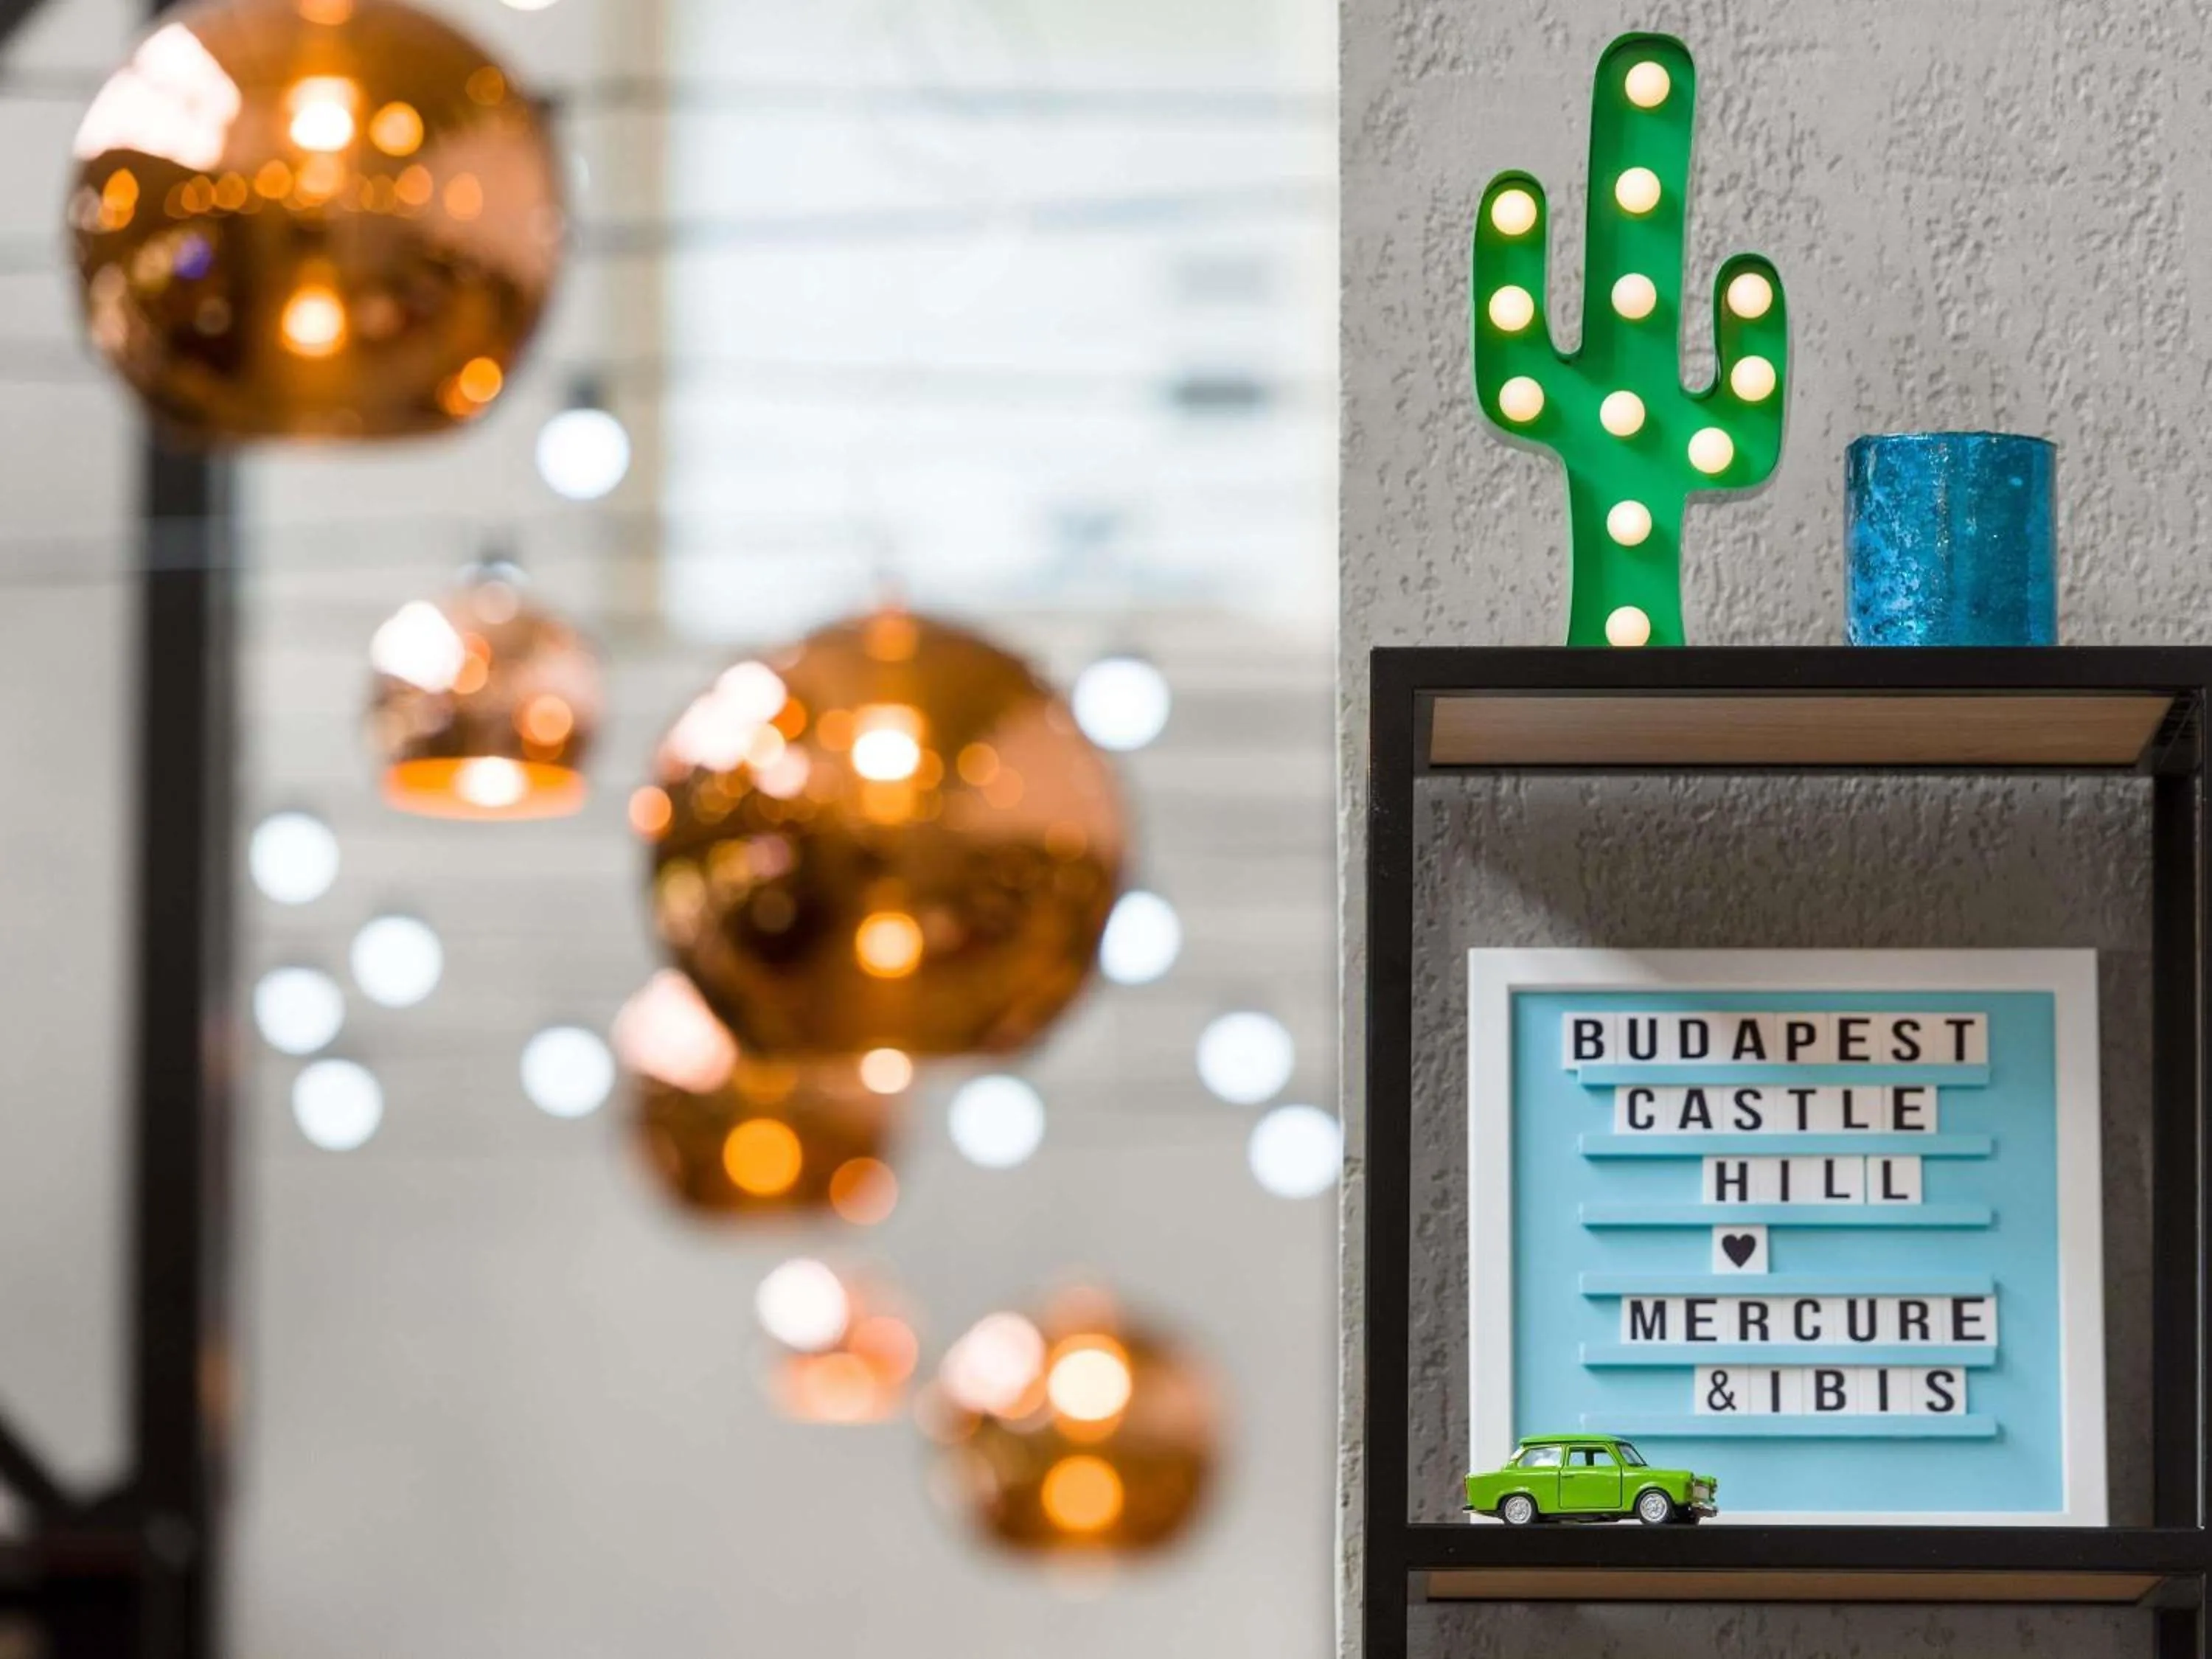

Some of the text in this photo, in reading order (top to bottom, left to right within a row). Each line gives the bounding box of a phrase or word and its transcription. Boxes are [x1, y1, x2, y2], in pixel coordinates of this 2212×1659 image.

[1573, 1018, 1975, 1062] BUDAPEST
[1628, 1086, 1925, 1131] CASTLE
[1716, 1158, 1908, 1202] HILL
[1630, 1296, 1986, 1342] MERCURE
[1708, 1368, 1955, 1412] & IBIS
